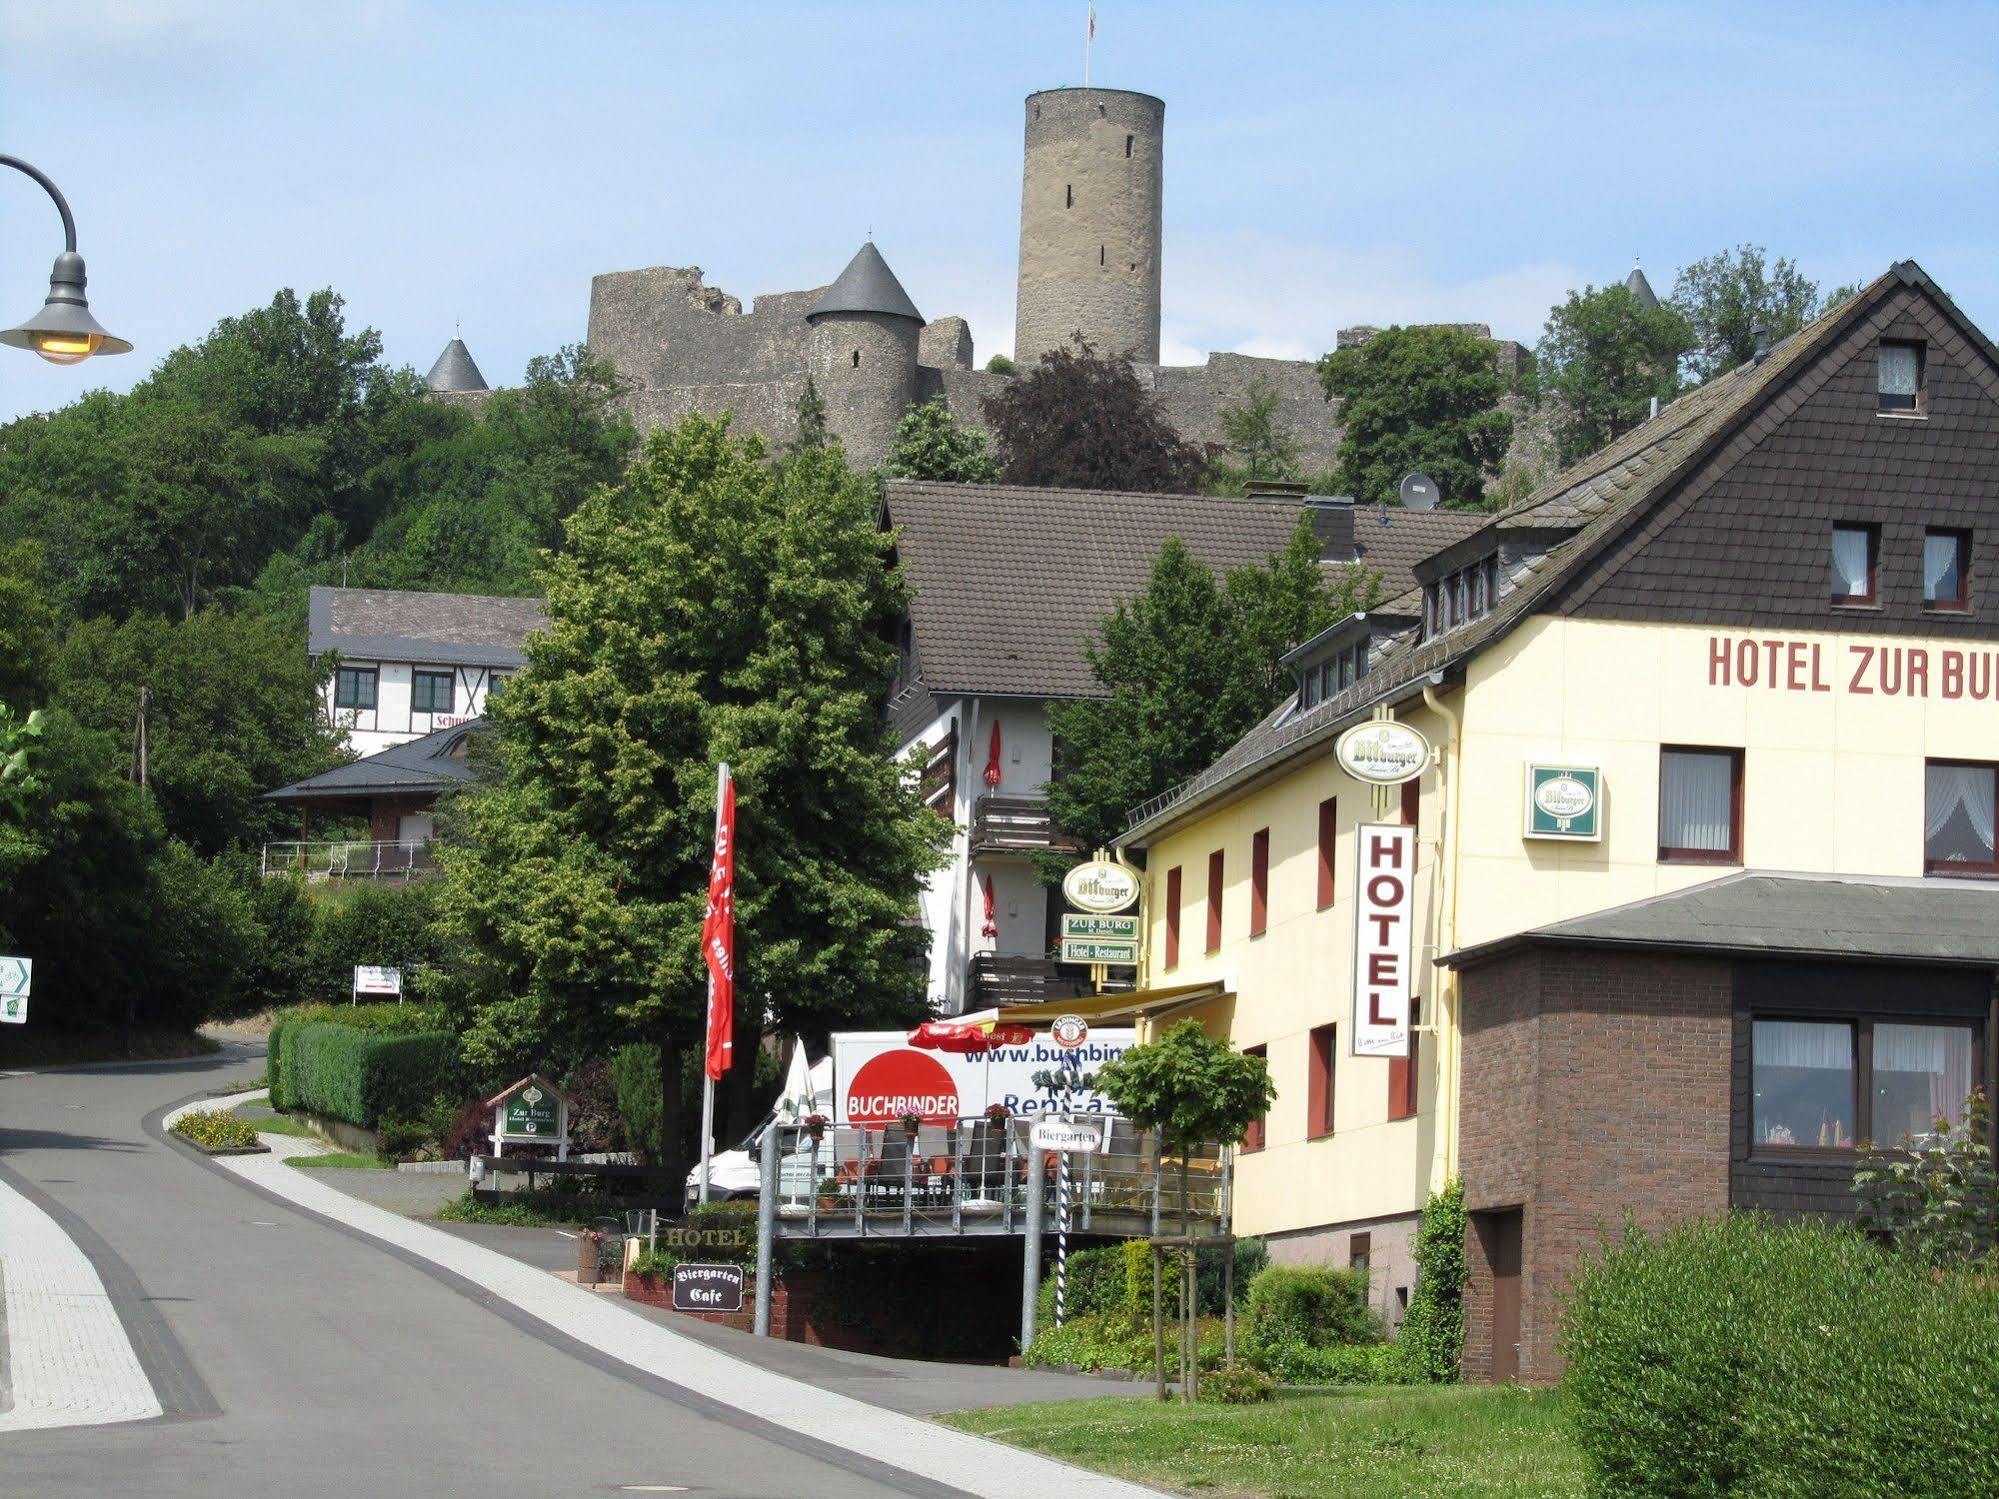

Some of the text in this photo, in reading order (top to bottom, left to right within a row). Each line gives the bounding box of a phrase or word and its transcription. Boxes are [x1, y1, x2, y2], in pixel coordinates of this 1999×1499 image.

[1708, 637, 1999, 701] HOTEL ZUR BU
[1071, 919, 1131, 930] ZUR BURG
[1367, 835, 1404, 1026] HOTEL
[1070, 944, 1089, 958] Hotel
[1095, 945, 1131, 959] Restaurant
[964, 1044, 1136, 1063] www.buhbin
[513, 1108, 550, 1118] Zur Burg
[848, 1095, 958, 1116] BUCHBINDER
[1038, 1128, 1095, 1142] Biergarten
[666, 1228, 747, 1247] HOTEL
[676, 1269, 740, 1285] Biergarten
[689, 1288, 723, 1305] Cafe
